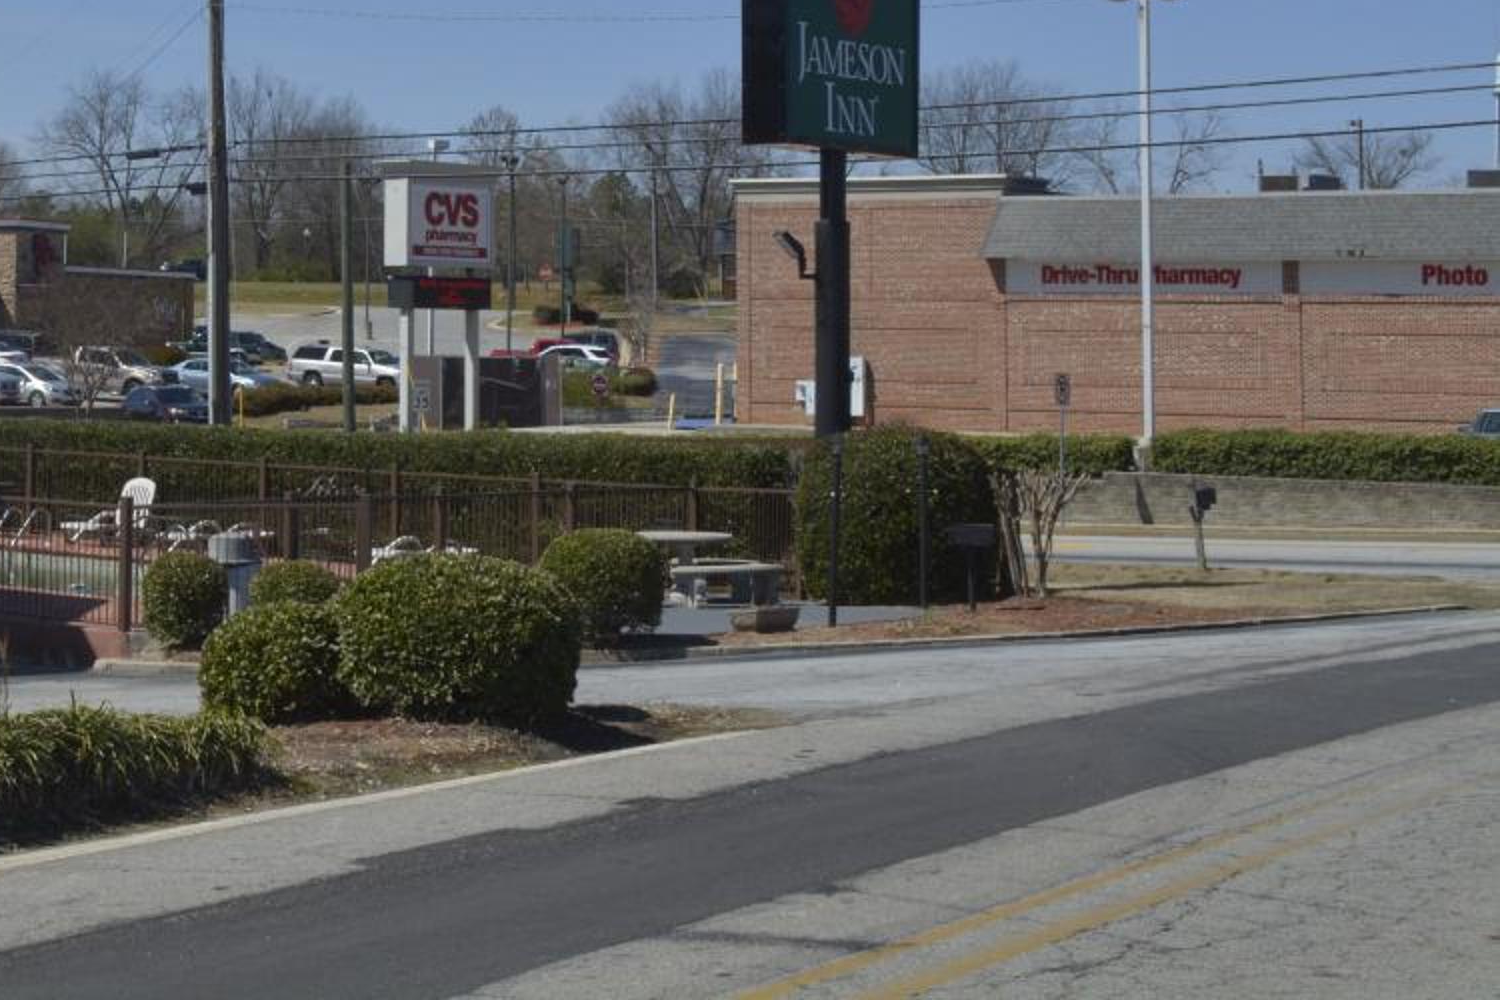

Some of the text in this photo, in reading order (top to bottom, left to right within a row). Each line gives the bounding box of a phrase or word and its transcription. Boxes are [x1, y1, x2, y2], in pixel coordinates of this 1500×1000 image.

[797, 20, 905, 88] JAMESON
[425, 191, 480, 228] CVS
[425, 229, 478, 247] pharmacy
[1041, 264, 1139, 285] Drive-Thru
[1421, 263, 1489, 287] Photo
